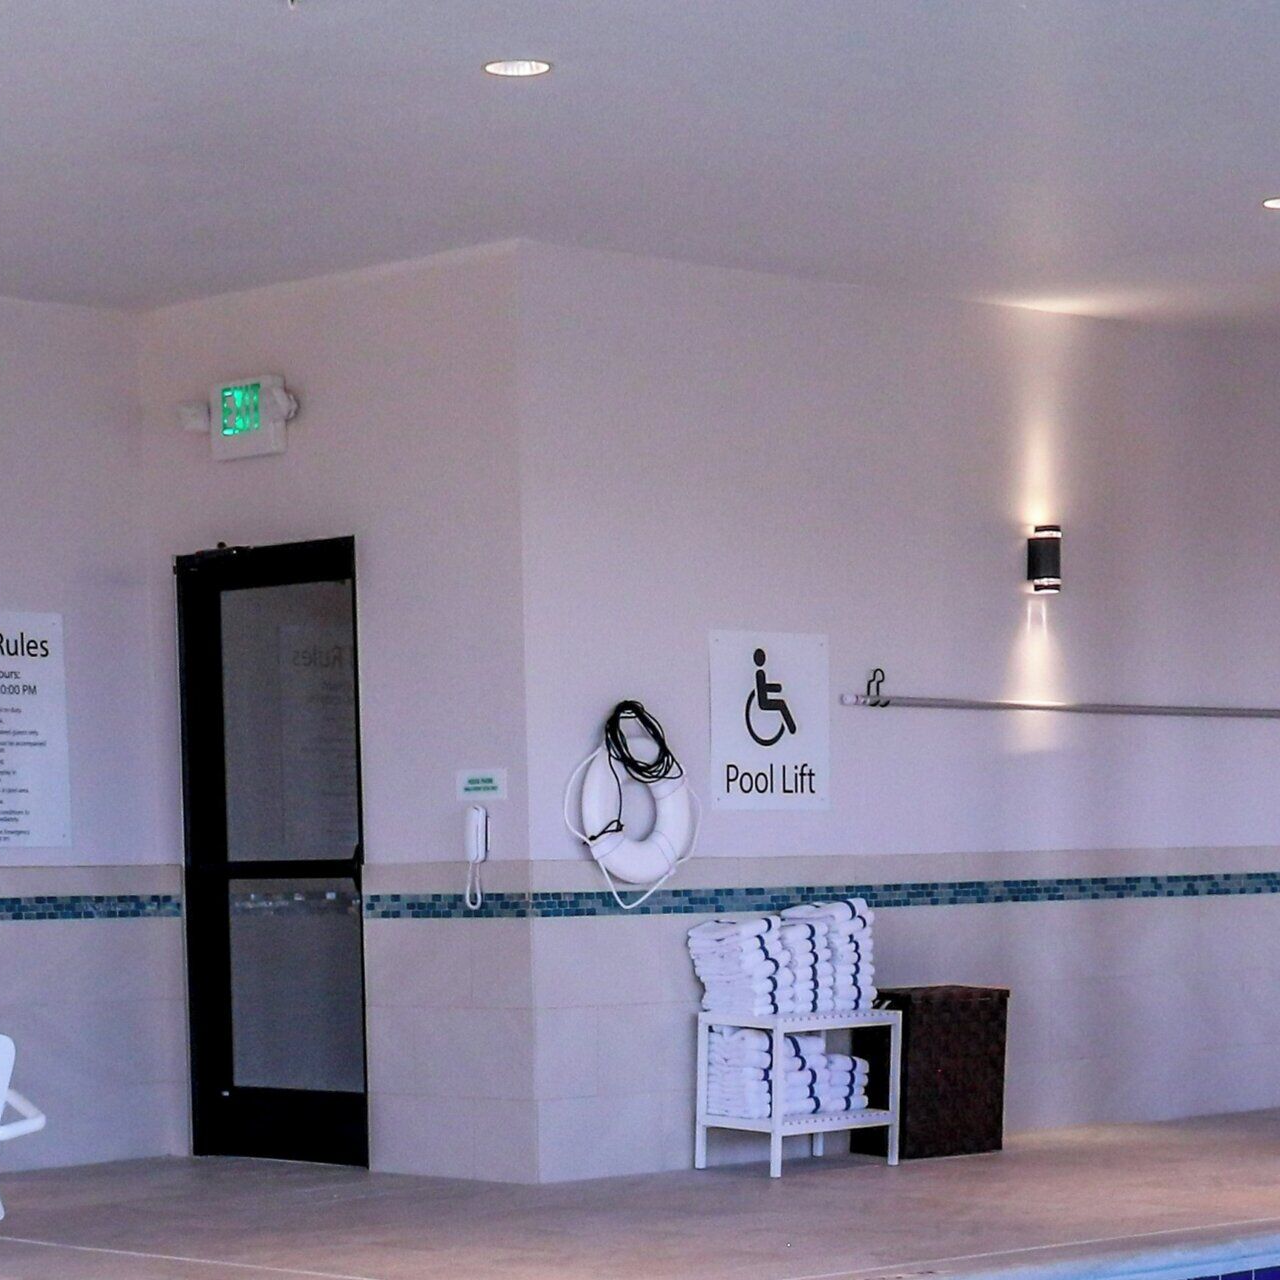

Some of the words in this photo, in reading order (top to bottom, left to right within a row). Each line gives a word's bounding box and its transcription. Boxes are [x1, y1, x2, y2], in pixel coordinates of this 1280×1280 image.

[22, 684, 37, 695] PM
[726, 763, 774, 794] Pool
[782, 763, 816, 794] Lift
